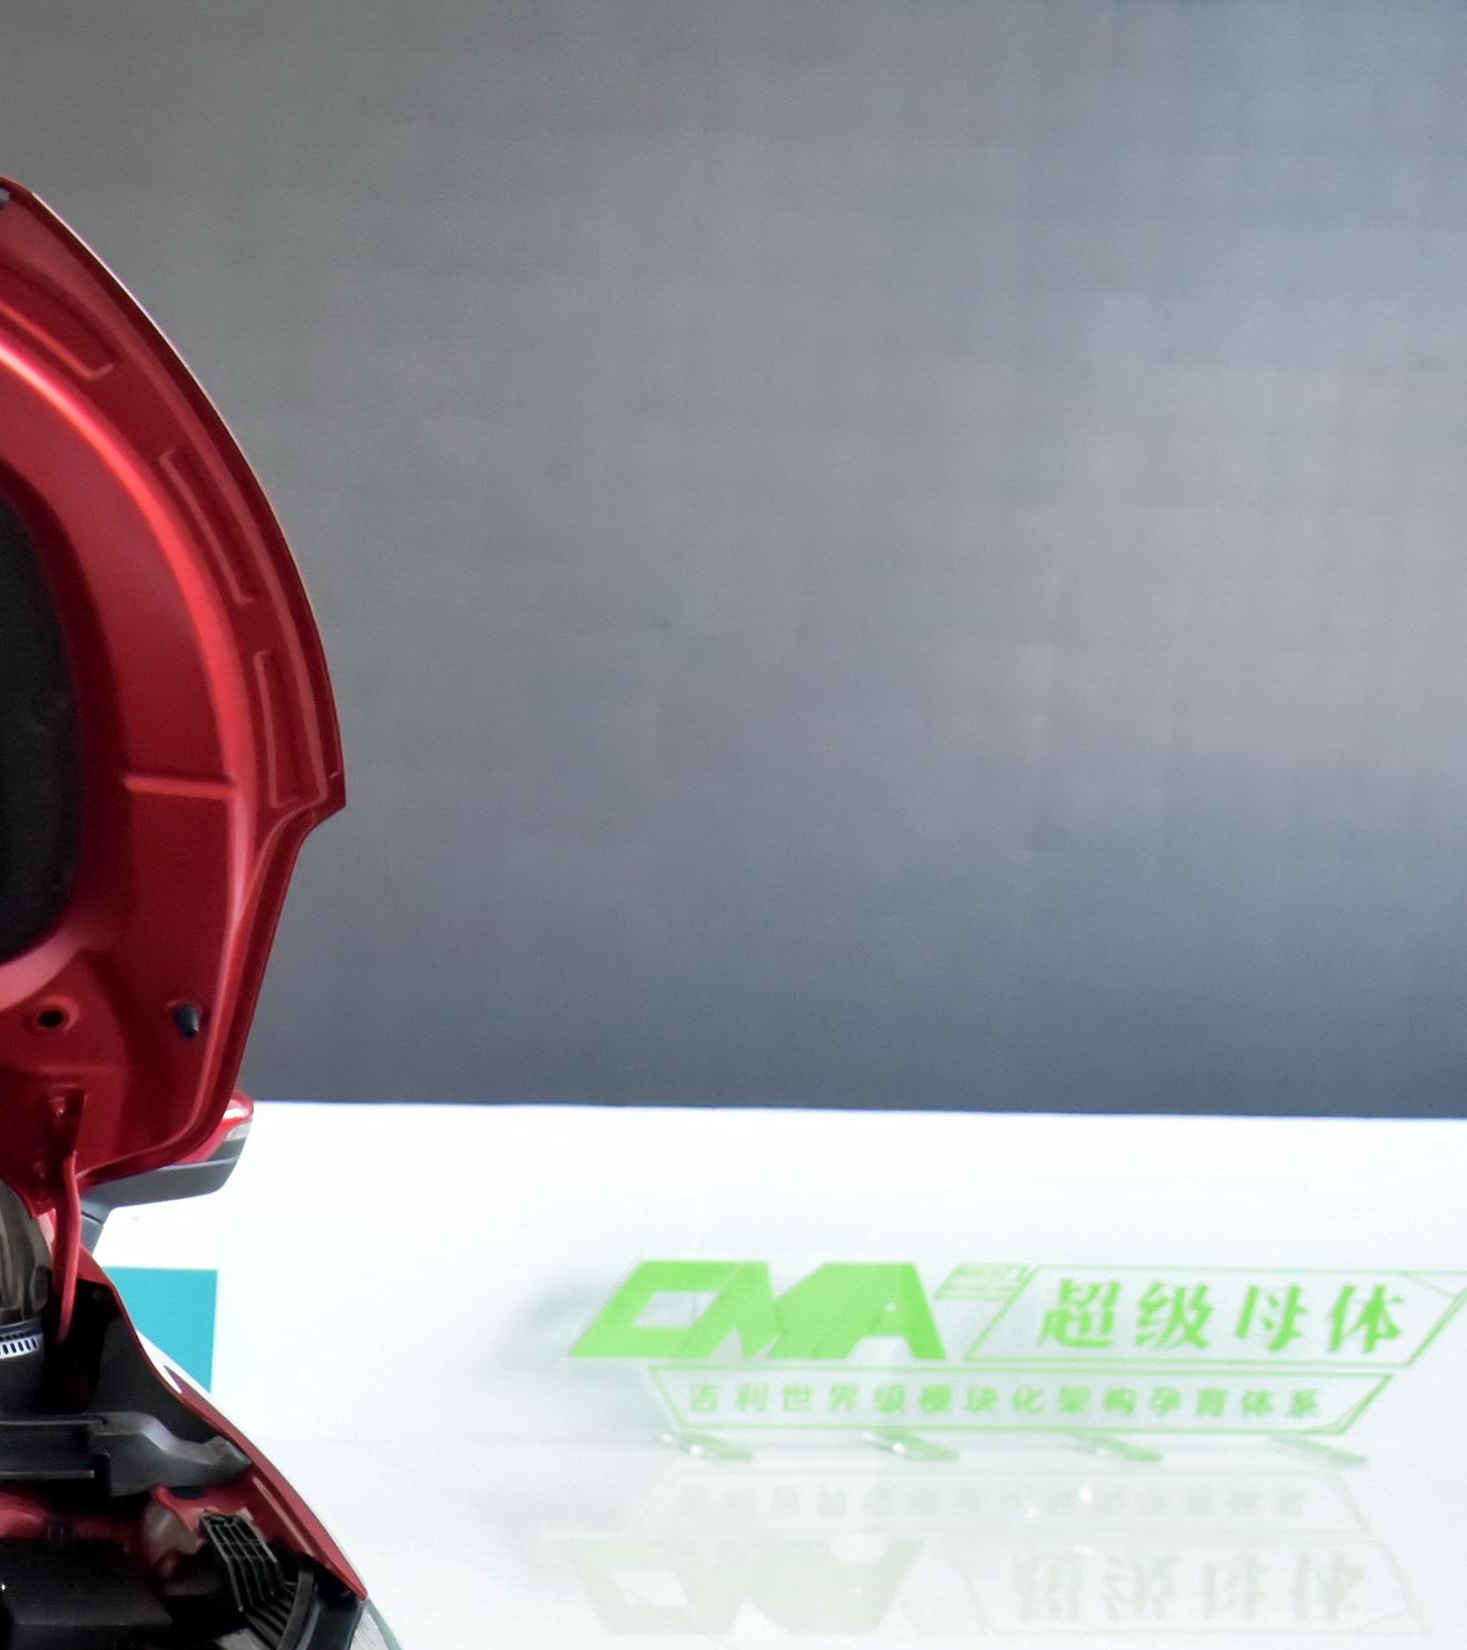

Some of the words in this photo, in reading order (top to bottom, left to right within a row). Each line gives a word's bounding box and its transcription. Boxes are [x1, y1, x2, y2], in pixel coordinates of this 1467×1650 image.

[568, 1260, 946, 1360] CMA
[1037, 1276, 1405, 1355] 超级母体
[687, 1382, 1322, 1419] 吉利世界级模块化架构孕育体系
